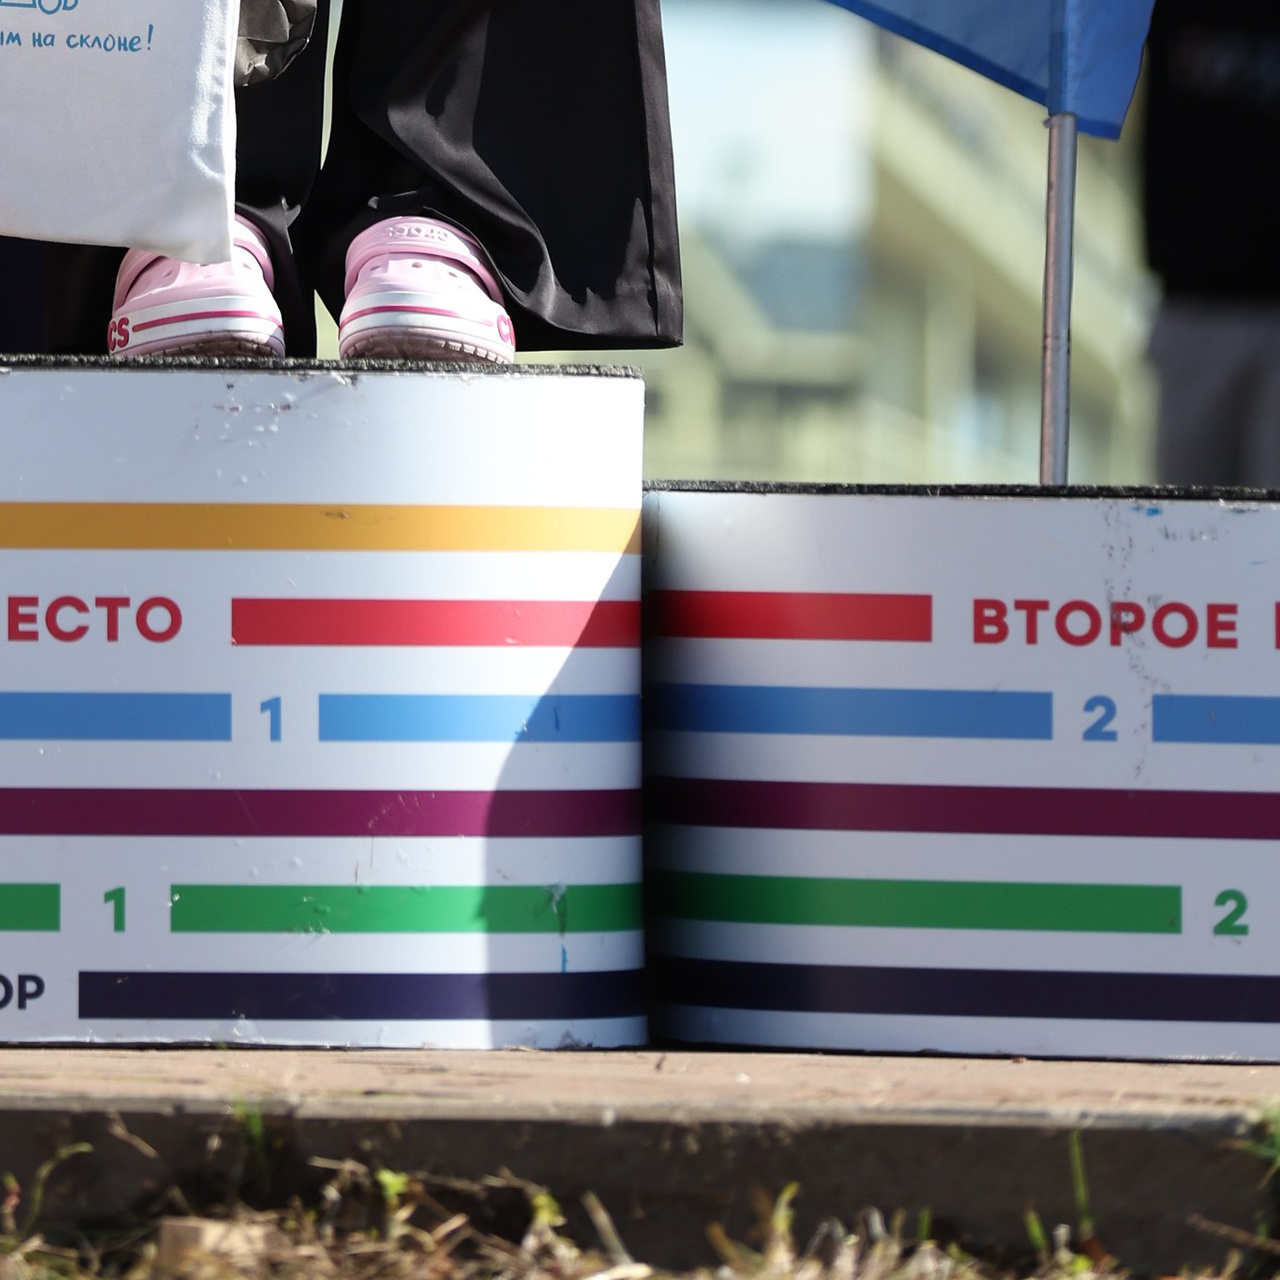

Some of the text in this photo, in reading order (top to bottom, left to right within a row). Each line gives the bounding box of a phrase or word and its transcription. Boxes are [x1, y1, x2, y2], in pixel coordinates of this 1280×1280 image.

[31, 29, 56, 49] на
[973, 598, 1239, 650] ВТОРОЕ
[260, 696, 282, 742] 1
[1082, 695, 1118, 741] 2
[103, 886, 126, 933] 1
[1213, 889, 1249, 936] 2
